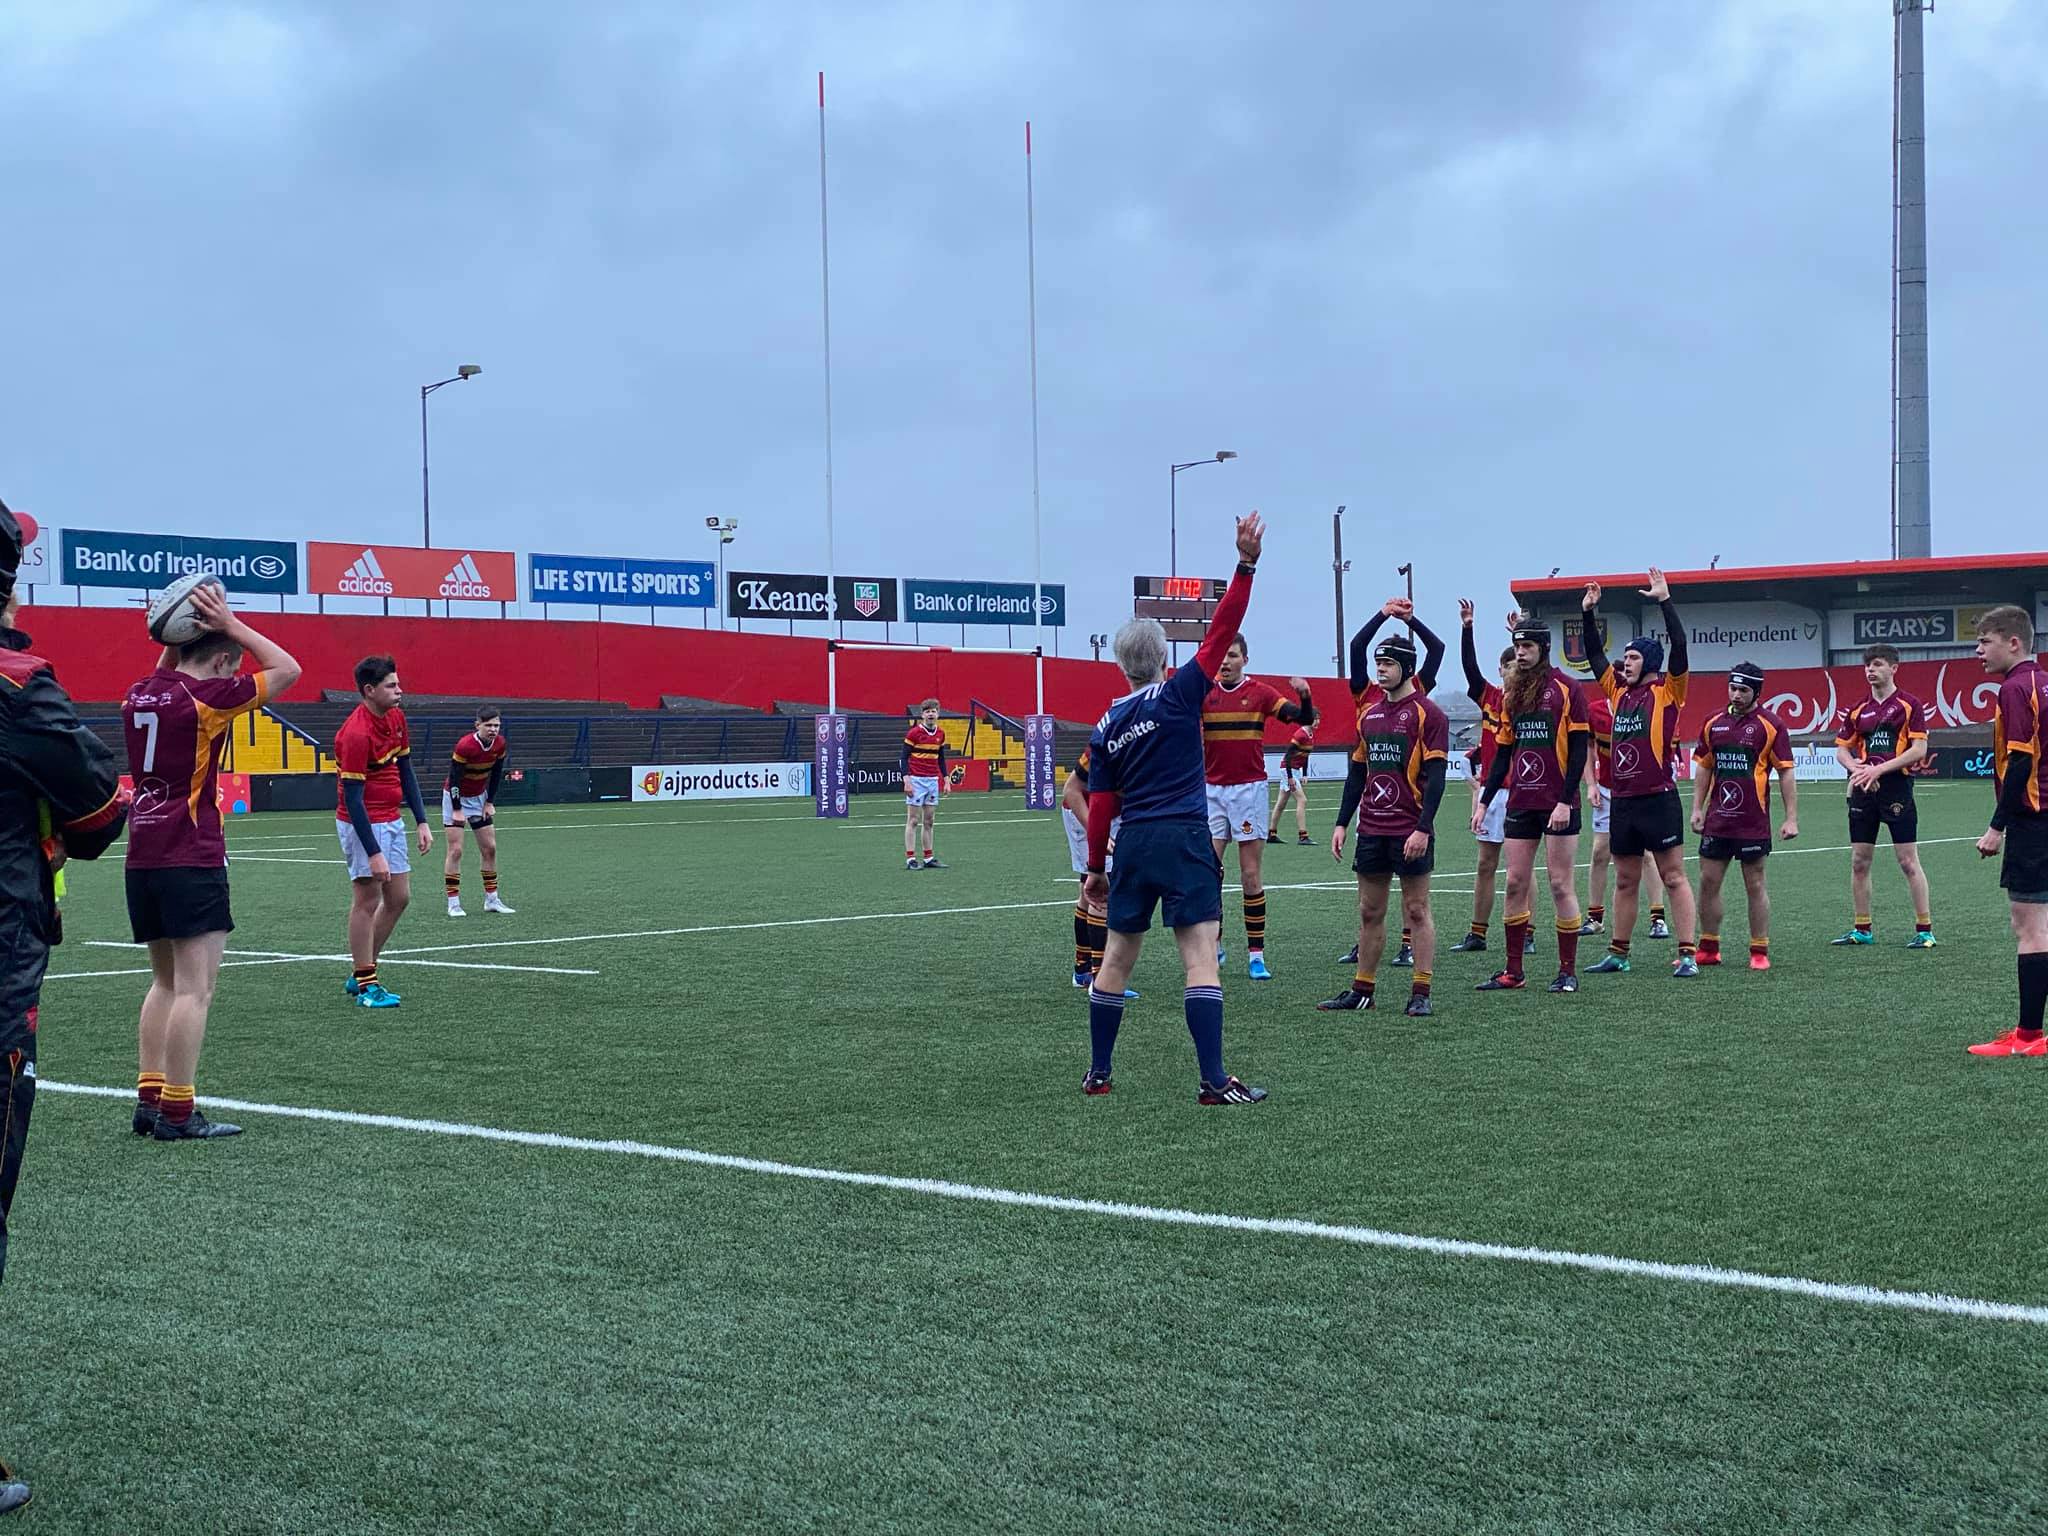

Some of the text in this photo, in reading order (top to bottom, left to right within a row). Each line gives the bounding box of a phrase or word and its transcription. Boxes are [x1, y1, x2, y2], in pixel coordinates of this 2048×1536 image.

[75, 546, 247, 577] Bank of Ireland
[338, 576, 393, 595] adidas
[439, 581, 491, 598] adidas
[534, 568, 701, 596] LIFE STYLE SPORTS
[858, 585, 876, 598] TAG
[737, 580, 838, 613] Keanes
[913, 592, 1030, 614] Bank of Ireland
[857, 600, 878, 613] HEUER
[1692, 625, 1799, 648] Independent
[1860, 616, 1947, 638] KEARYS
[133, 711, 159, 773] 7
[1369, 743, 1401, 753] MICHAEL
[1369, 752, 1401, 762] GRAHAM
[1716, 752, 1748, 762] MICHAEL
[1717, 761, 1748, 770] GRAHAM
[664, 768, 780, 796] ajproducts.ie
[858, 769, 885, 783] DALY
